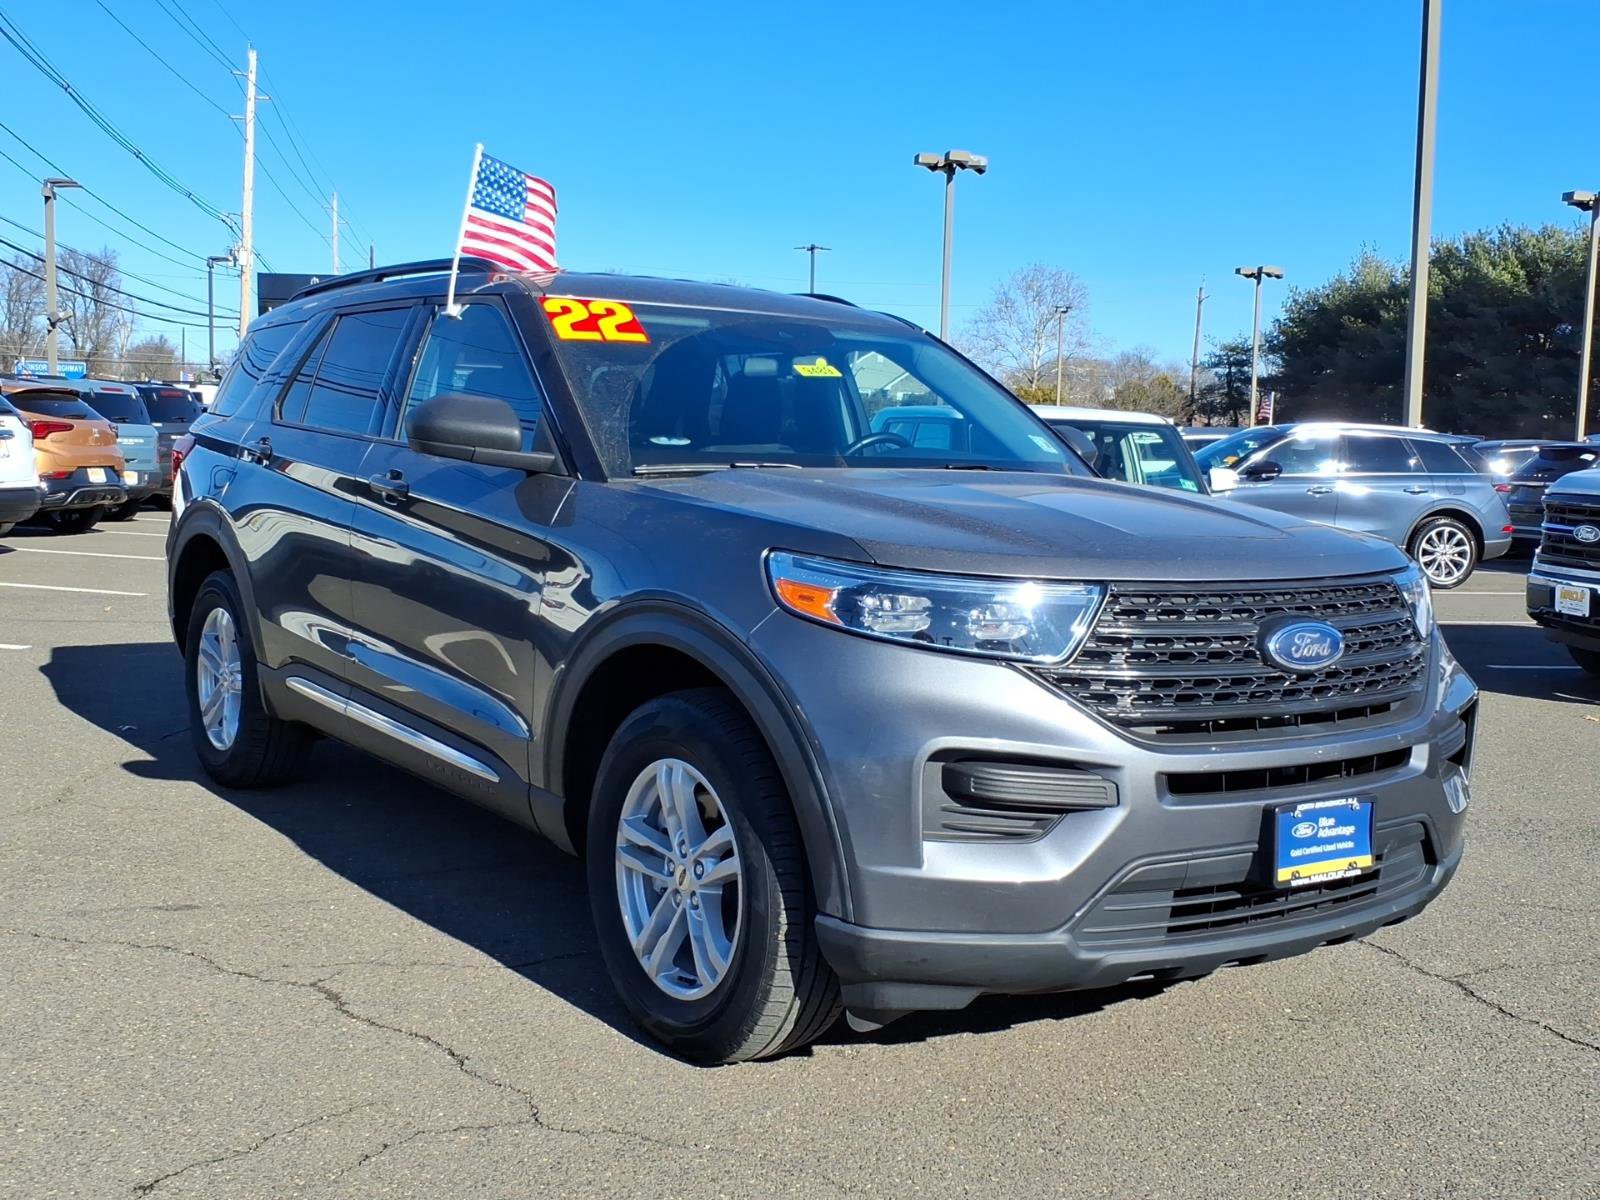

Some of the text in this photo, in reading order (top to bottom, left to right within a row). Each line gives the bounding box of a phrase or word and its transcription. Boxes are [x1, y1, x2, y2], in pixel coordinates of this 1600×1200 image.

[543, 298, 648, 342] 22
[1291, 632, 1331, 658] Ford
[1318, 816, 1336, 827] Blue
[1295, 824, 1313, 836] Ford
[1317, 826, 1355, 838] Advantage
[1290, 848, 1303, 857] Gold
